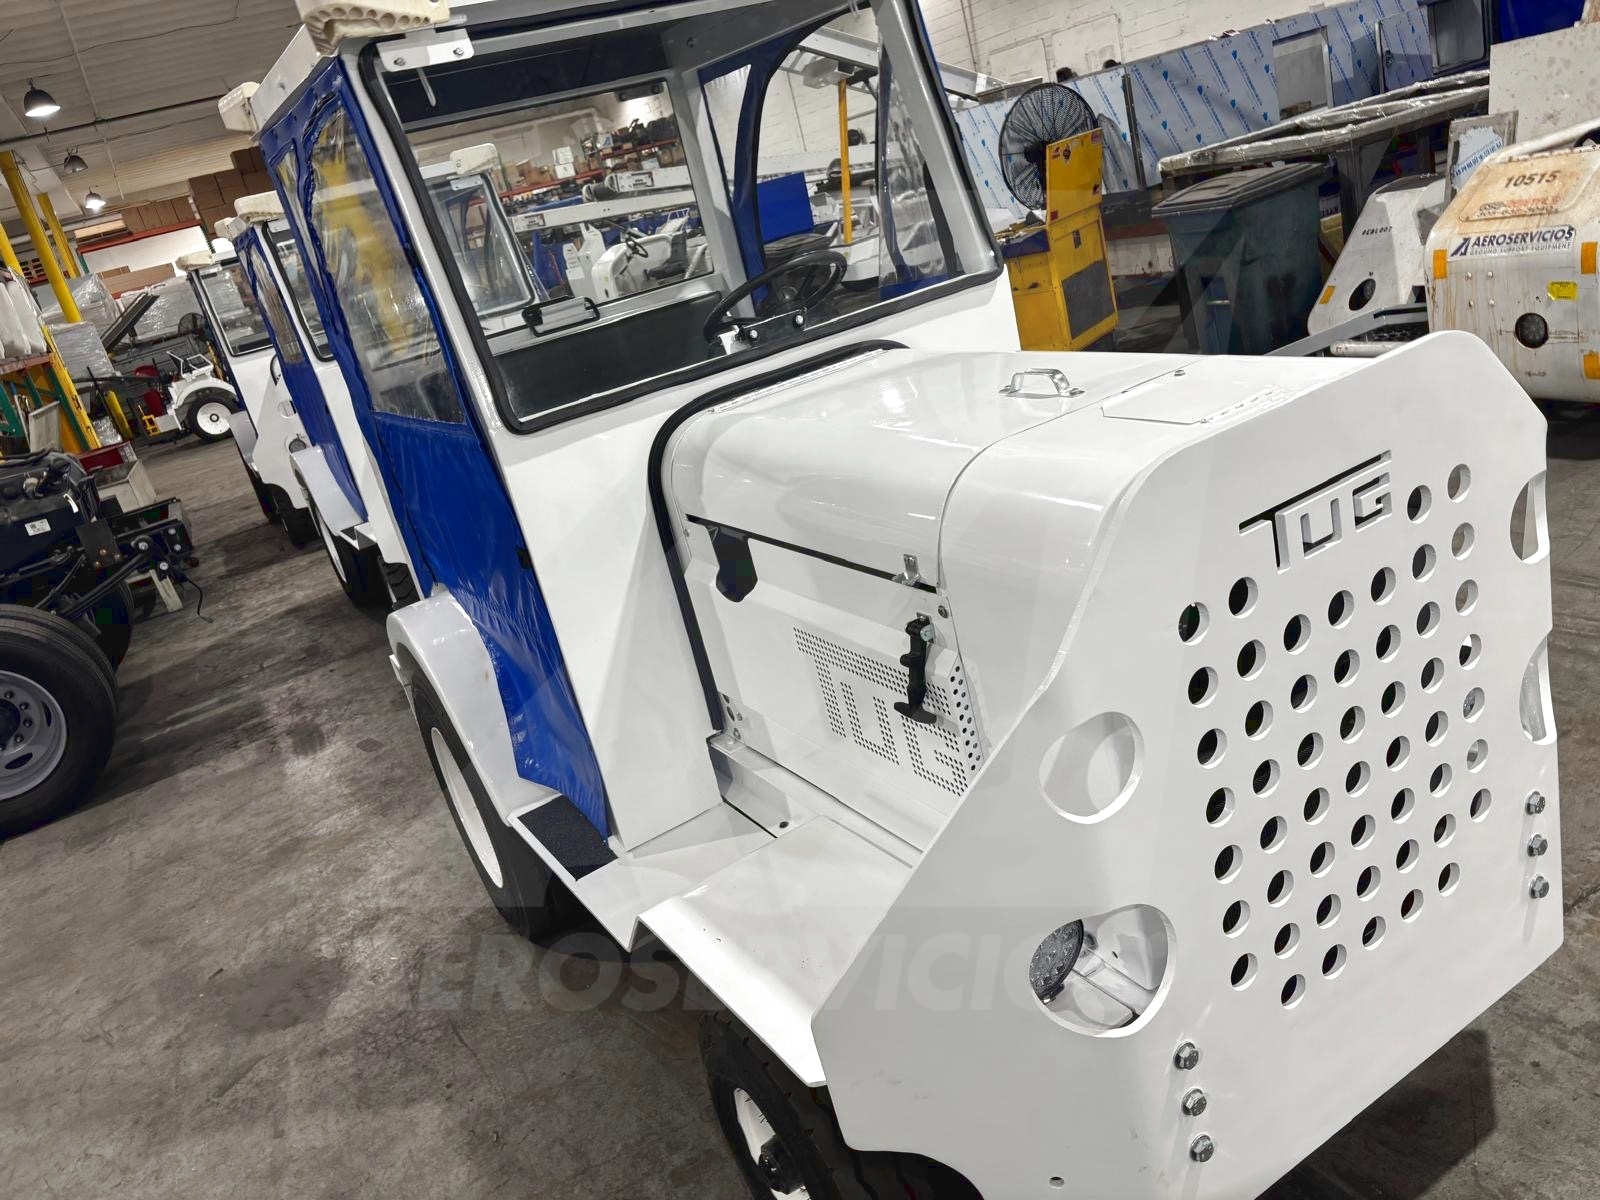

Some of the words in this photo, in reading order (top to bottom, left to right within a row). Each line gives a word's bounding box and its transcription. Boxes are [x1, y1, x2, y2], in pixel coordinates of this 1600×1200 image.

[1505, 170, 1561, 188] 10515
[1471, 227, 1576, 248] AEROSERVICIOS
[1531, 243, 1571, 252] EQUIPMENT
[1238, 449, 1393, 575] TUG
[793, 627, 969, 798] TUG
